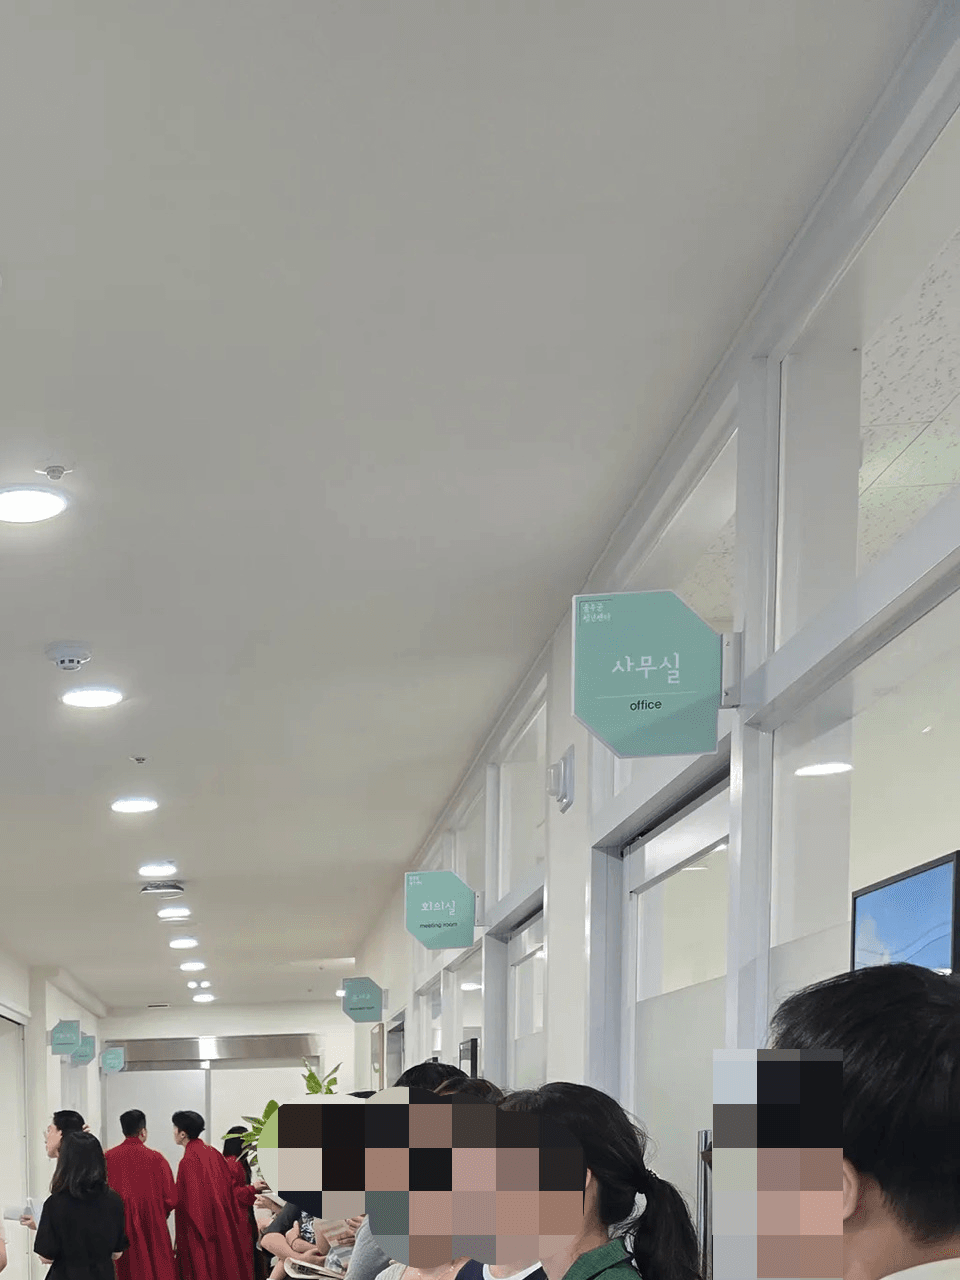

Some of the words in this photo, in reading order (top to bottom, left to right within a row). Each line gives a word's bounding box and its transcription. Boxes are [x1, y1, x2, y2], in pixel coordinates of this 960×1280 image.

[611, 652, 681, 684] 사무실
[629, 699, 662, 711] office
[420, 900, 456, 916] 회의실
